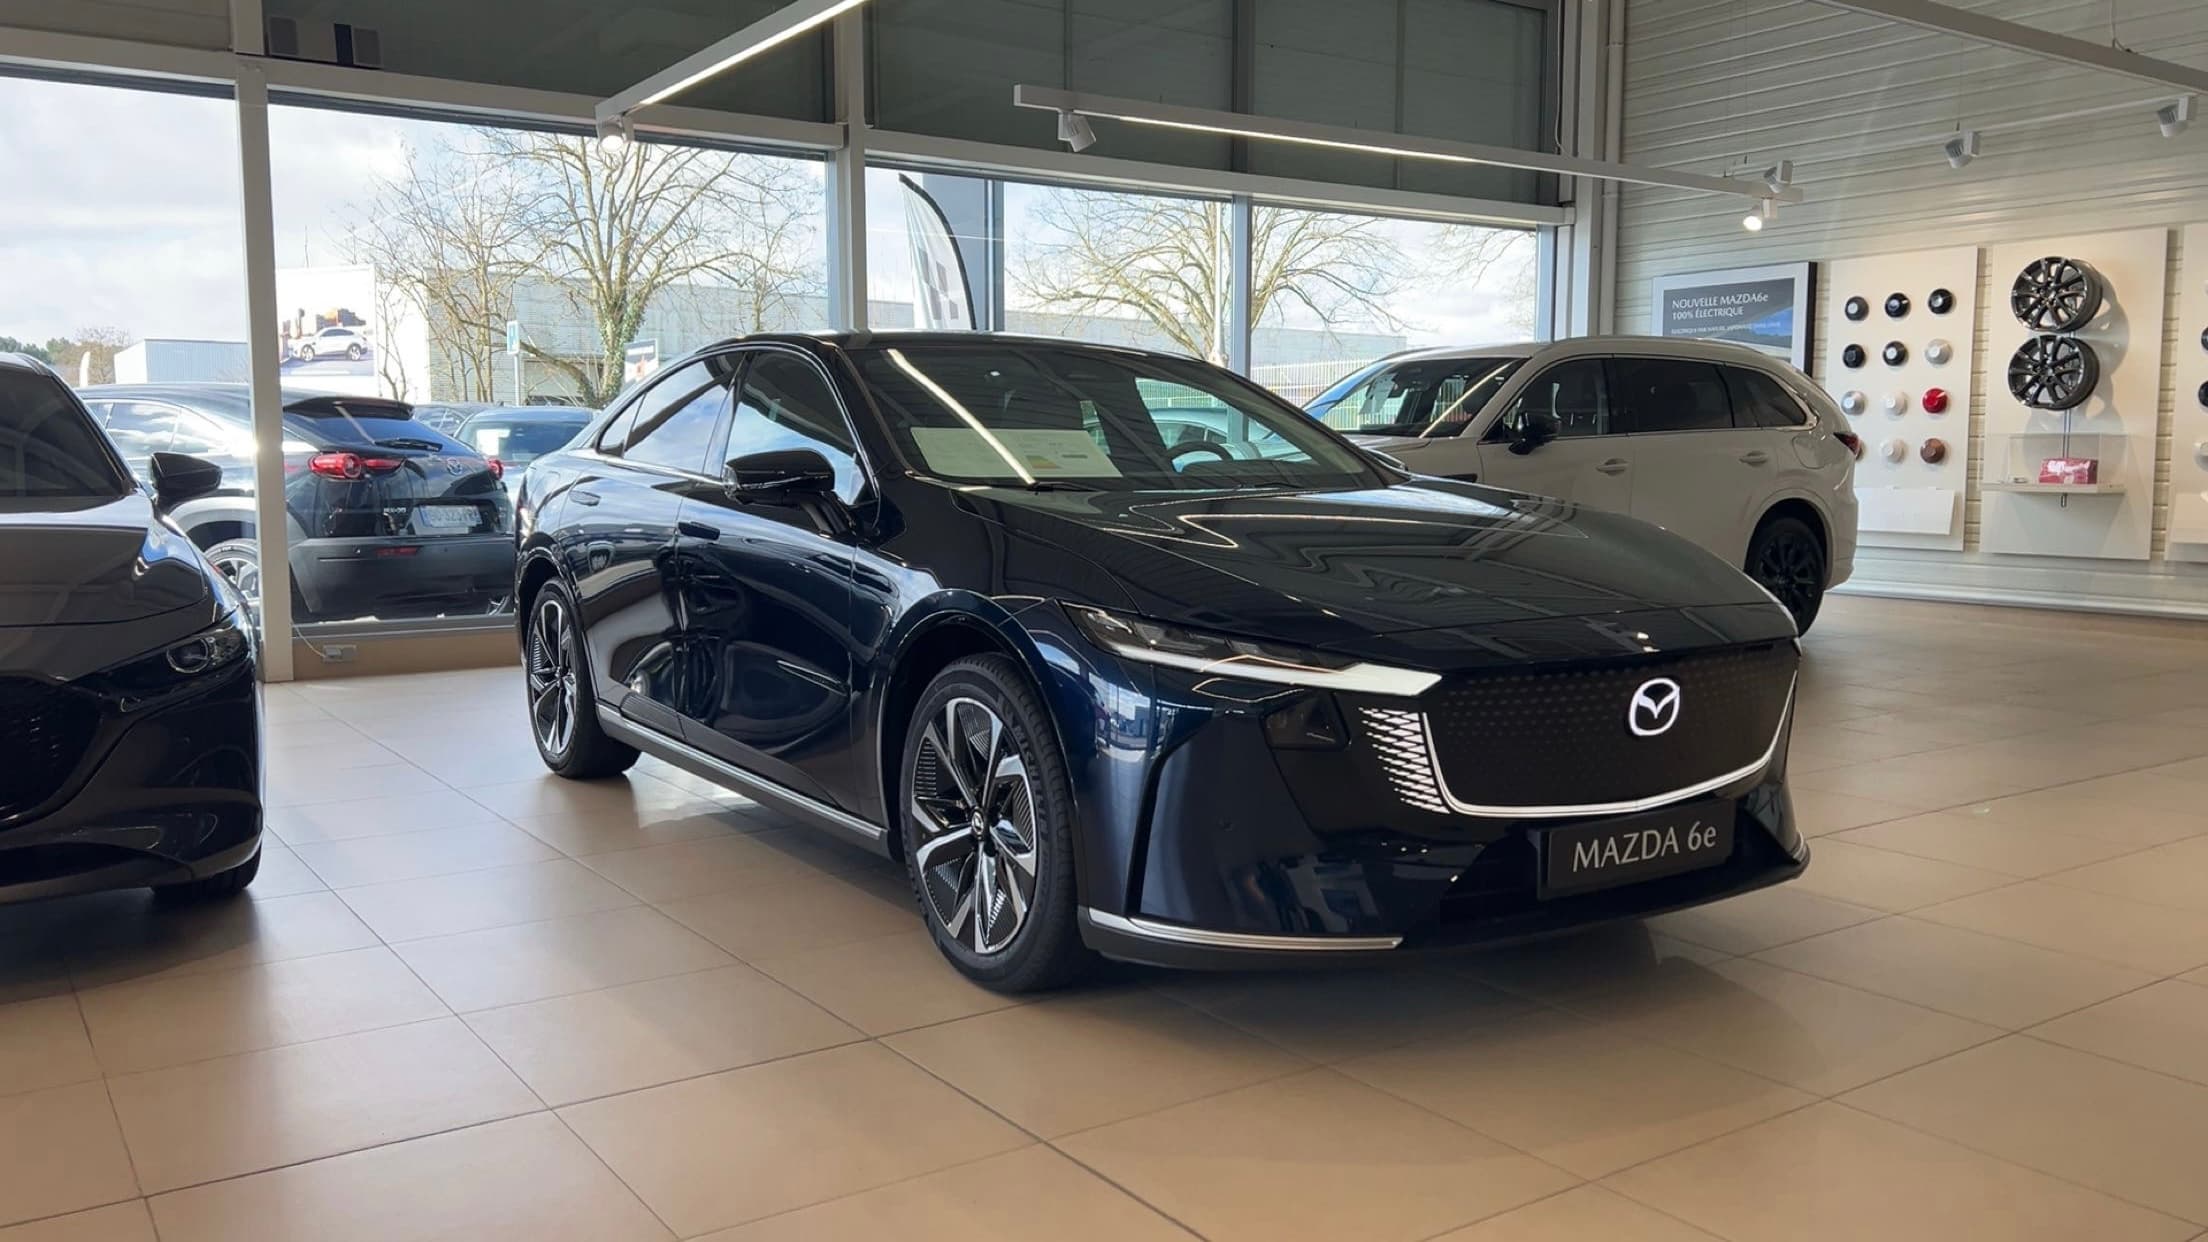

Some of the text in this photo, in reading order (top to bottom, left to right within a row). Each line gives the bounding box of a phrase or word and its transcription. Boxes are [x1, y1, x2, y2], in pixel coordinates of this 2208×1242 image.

[1672, 292, 1768, 309] NOUVELLE MAZDA6e
[1672, 306, 1744, 321] 100% ÉLECTRIQUE
[1572, 820, 1717, 873] MAZDA 6e
